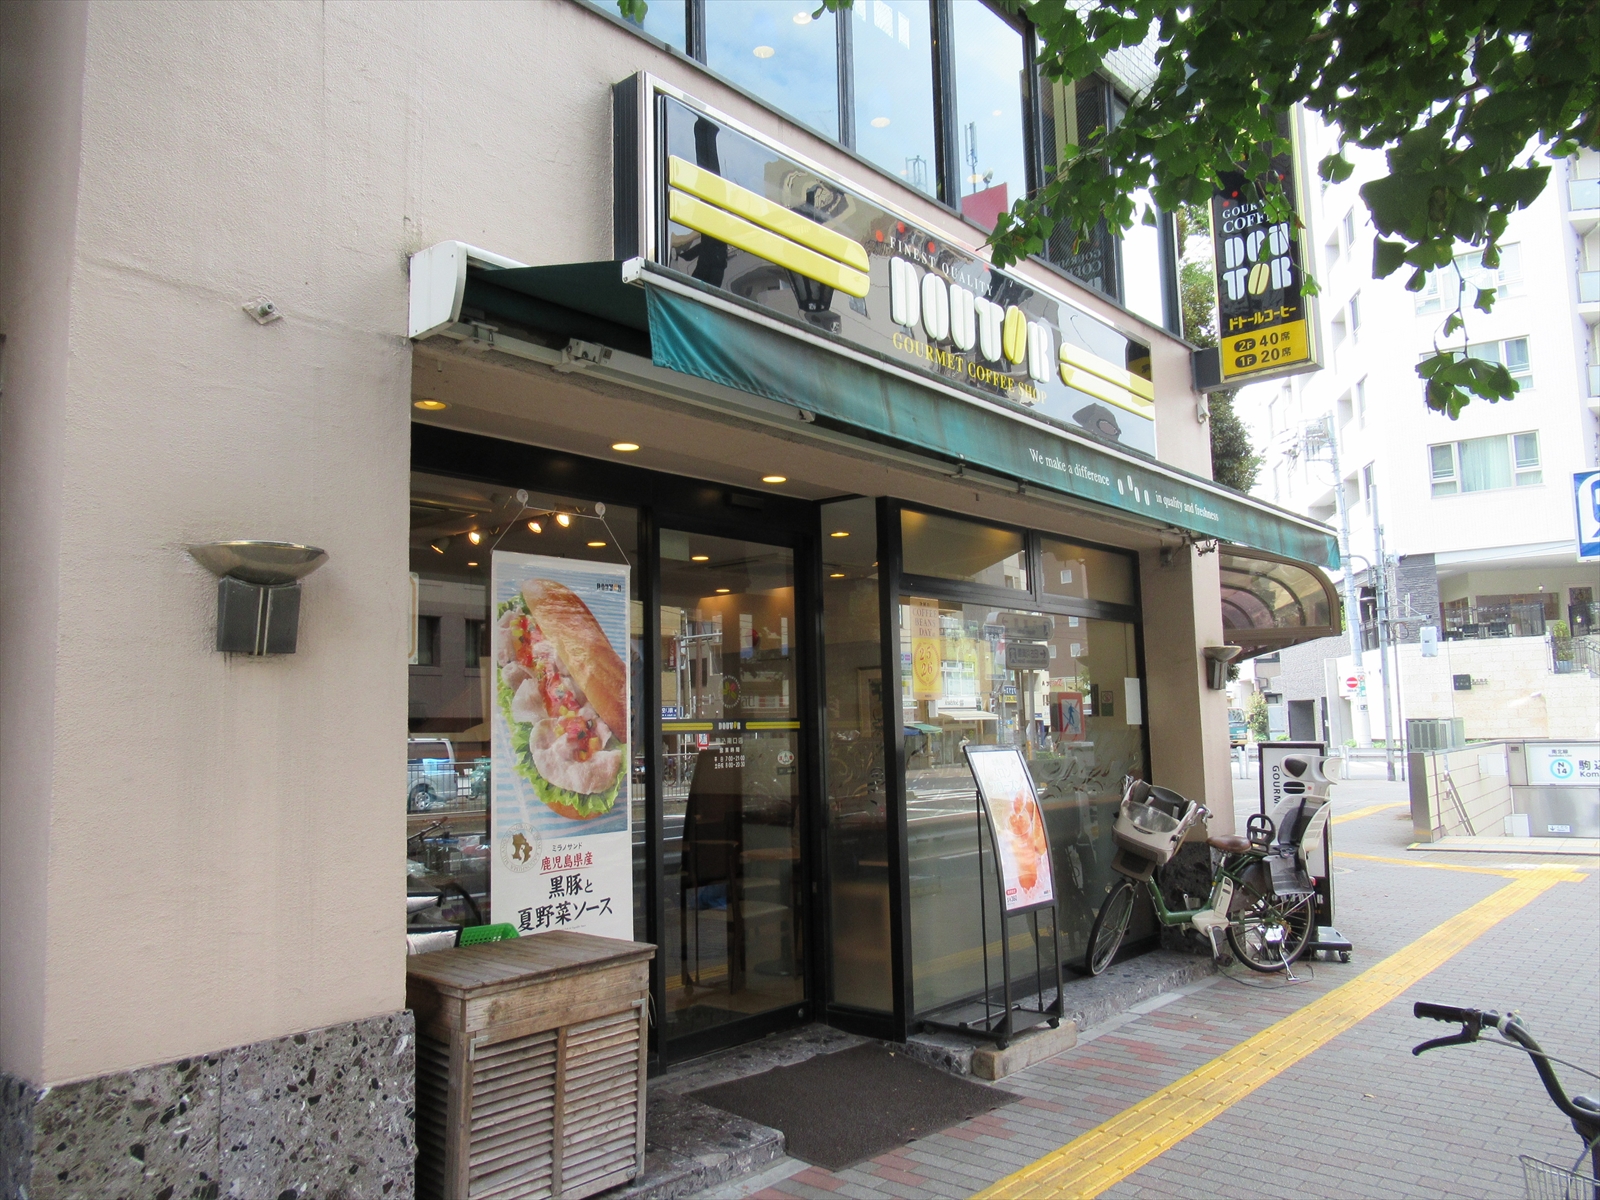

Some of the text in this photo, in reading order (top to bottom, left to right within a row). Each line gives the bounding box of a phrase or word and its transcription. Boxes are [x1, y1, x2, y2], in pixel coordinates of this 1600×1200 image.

[1222, 211, 1270, 233] COFF
[890, 236, 993, 297] FINEST QUALITY
[1222, 256, 1292, 301] TOR
[890, 256, 1050, 384] DOUTOR
[1229, 305, 1297, 331] ドトールコーヒー
[1238, 340, 1253, 352] 2F
[892, 332, 1047, 404] GOURMET COFFEE SHOP
[1239, 356, 1253, 366] 1F
[1028, 448, 1219, 522] We make a difference in quality and freshness
[912, 607, 938, 618] COFFEE
[914, 617, 936, 628] BEANS
[919, 627, 933, 637] DAY
[919, 645, 932, 660] 25
[921, 661, 933, 677] 26
[1272, 765, 1281, 804] GOURM
[551, 842, 583, 853] ミラノサンド
[540, 851, 594, 871] 鹿児島県産
[548, 873, 594, 899] 黒豚と
[517, 897, 613, 932] 夏野菜ソース
